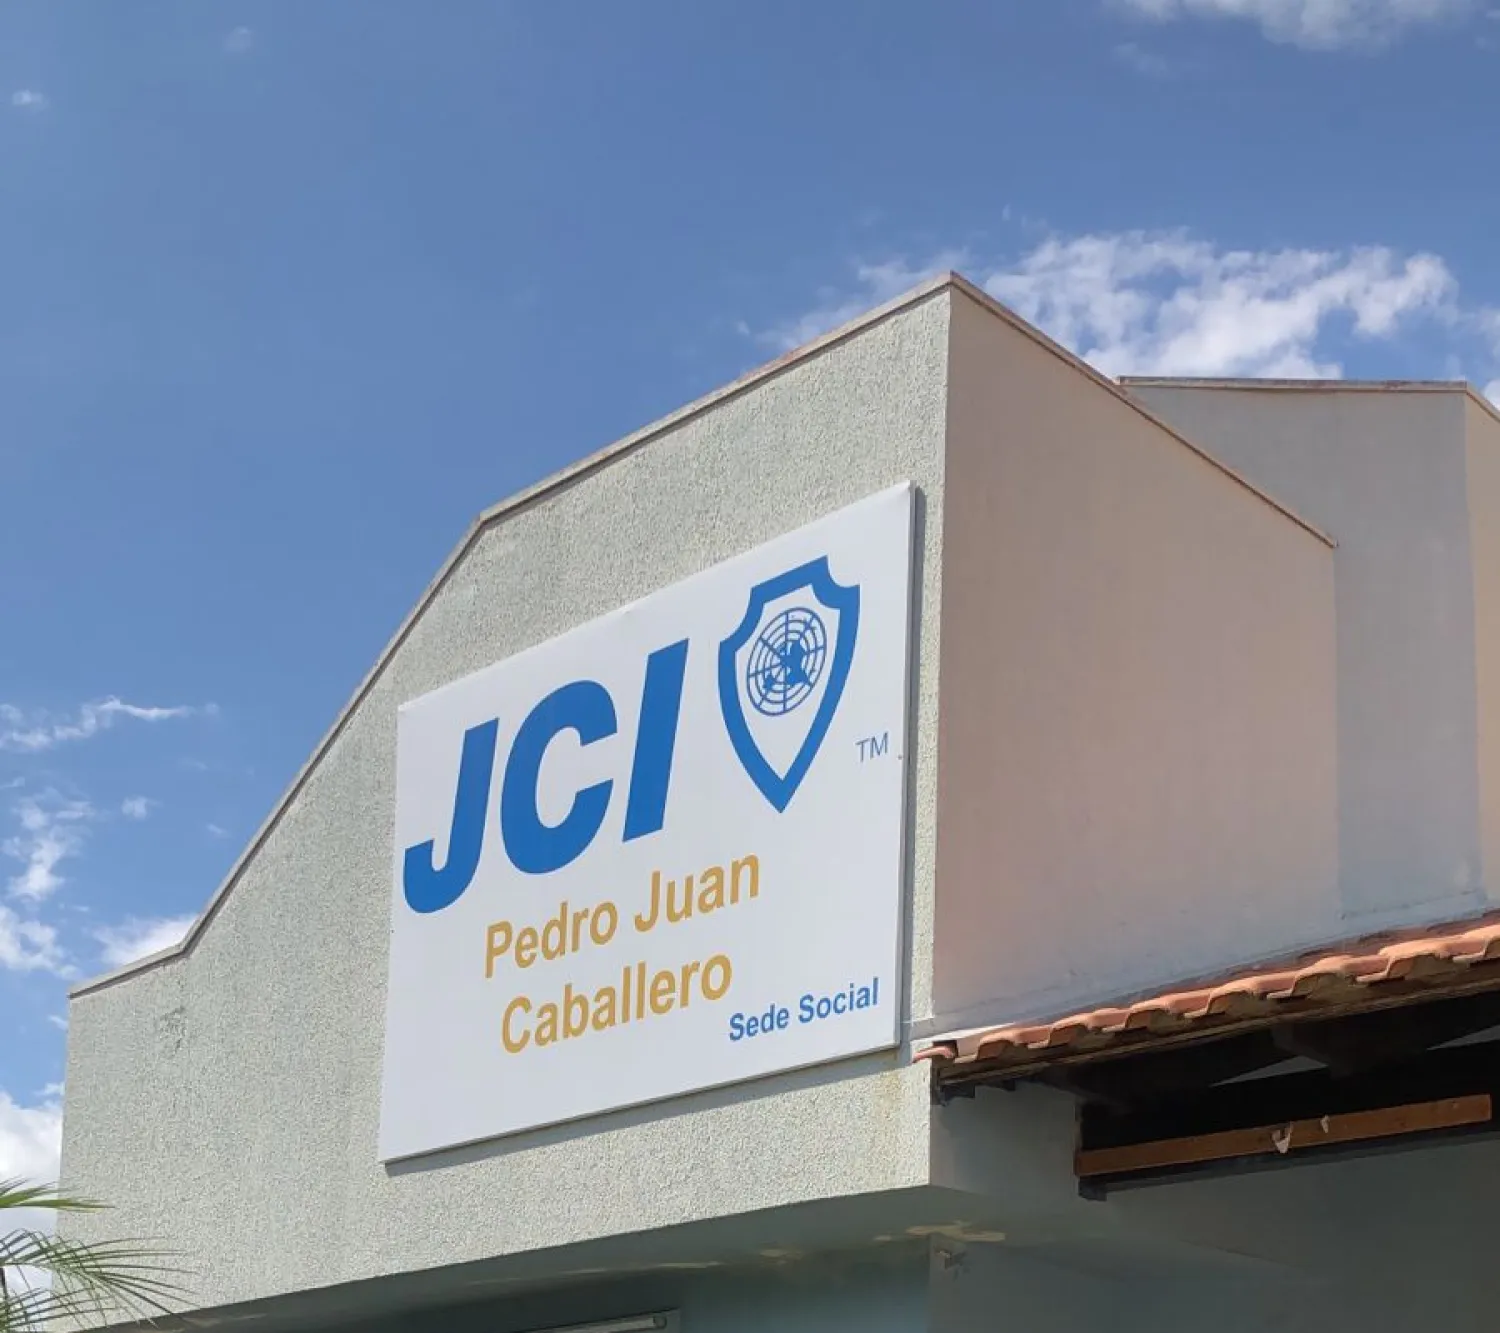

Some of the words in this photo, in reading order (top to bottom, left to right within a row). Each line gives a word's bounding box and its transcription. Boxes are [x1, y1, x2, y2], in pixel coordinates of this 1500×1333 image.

[402, 637, 690, 914] JCI
[856, 731, 890, 763] TM
[484, 901, 618, 978] Pedro
[634, 854, 760, 933] Juan
[501, 953, 733, 1054] Caballero
[728, 1007, 791, 1041] Sede
[798, 976, 880, 1025] Social
